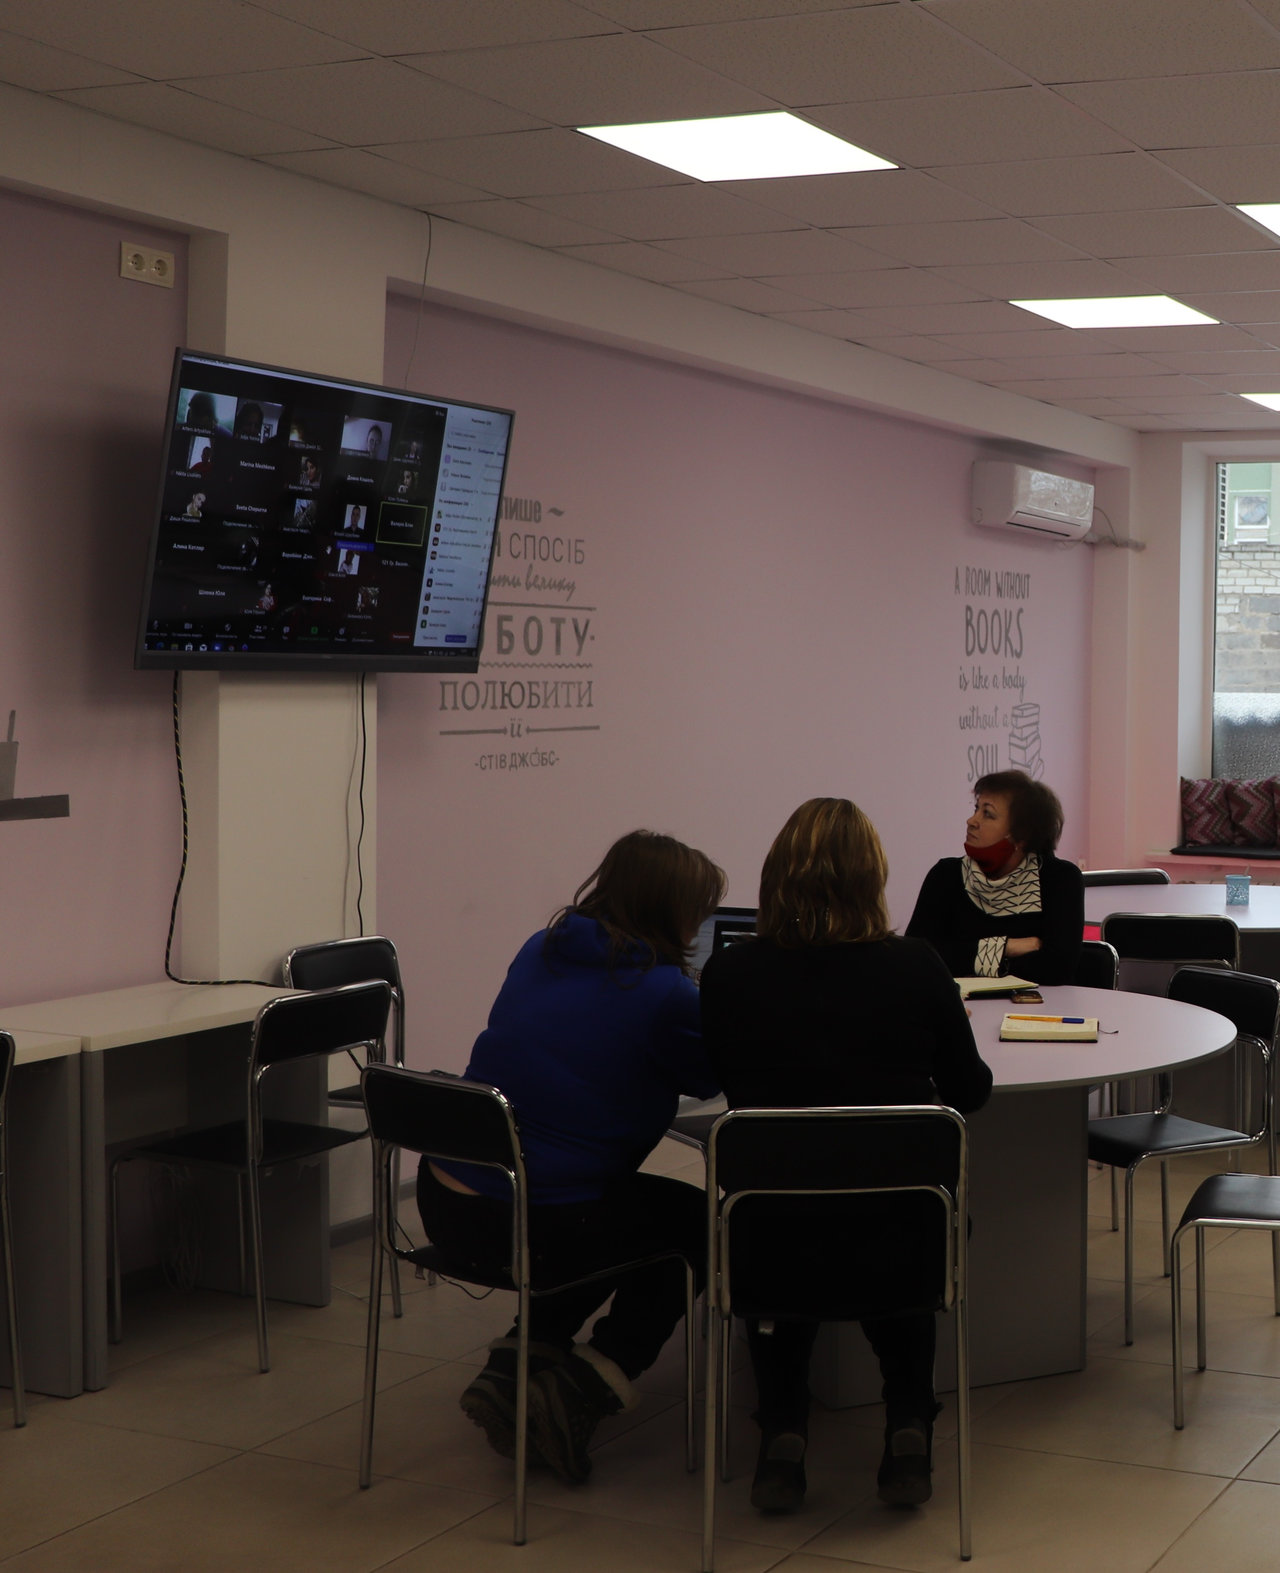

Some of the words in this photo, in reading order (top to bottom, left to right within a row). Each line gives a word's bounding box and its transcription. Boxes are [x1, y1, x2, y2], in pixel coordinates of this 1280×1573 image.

[509, 532, 585, 565] СПОСІБ
[954, 566, 961, 595] A
[965, 566, 991, 597] ROOM
[995, 570, 1031, 599] WITHOUT
[496, 614, 590, 656] БОТУ
[965, 605, 1024, 658] BOOKS
[439, 680, 594, 711] ПОЛЮБИТИ
[959, 666, 969, 691] is
[972, 665, 989, 689] like
[993, 674, 999, 689] a
[1002, 665, 1025, 703] body
[959, 704, 999, 730] without
